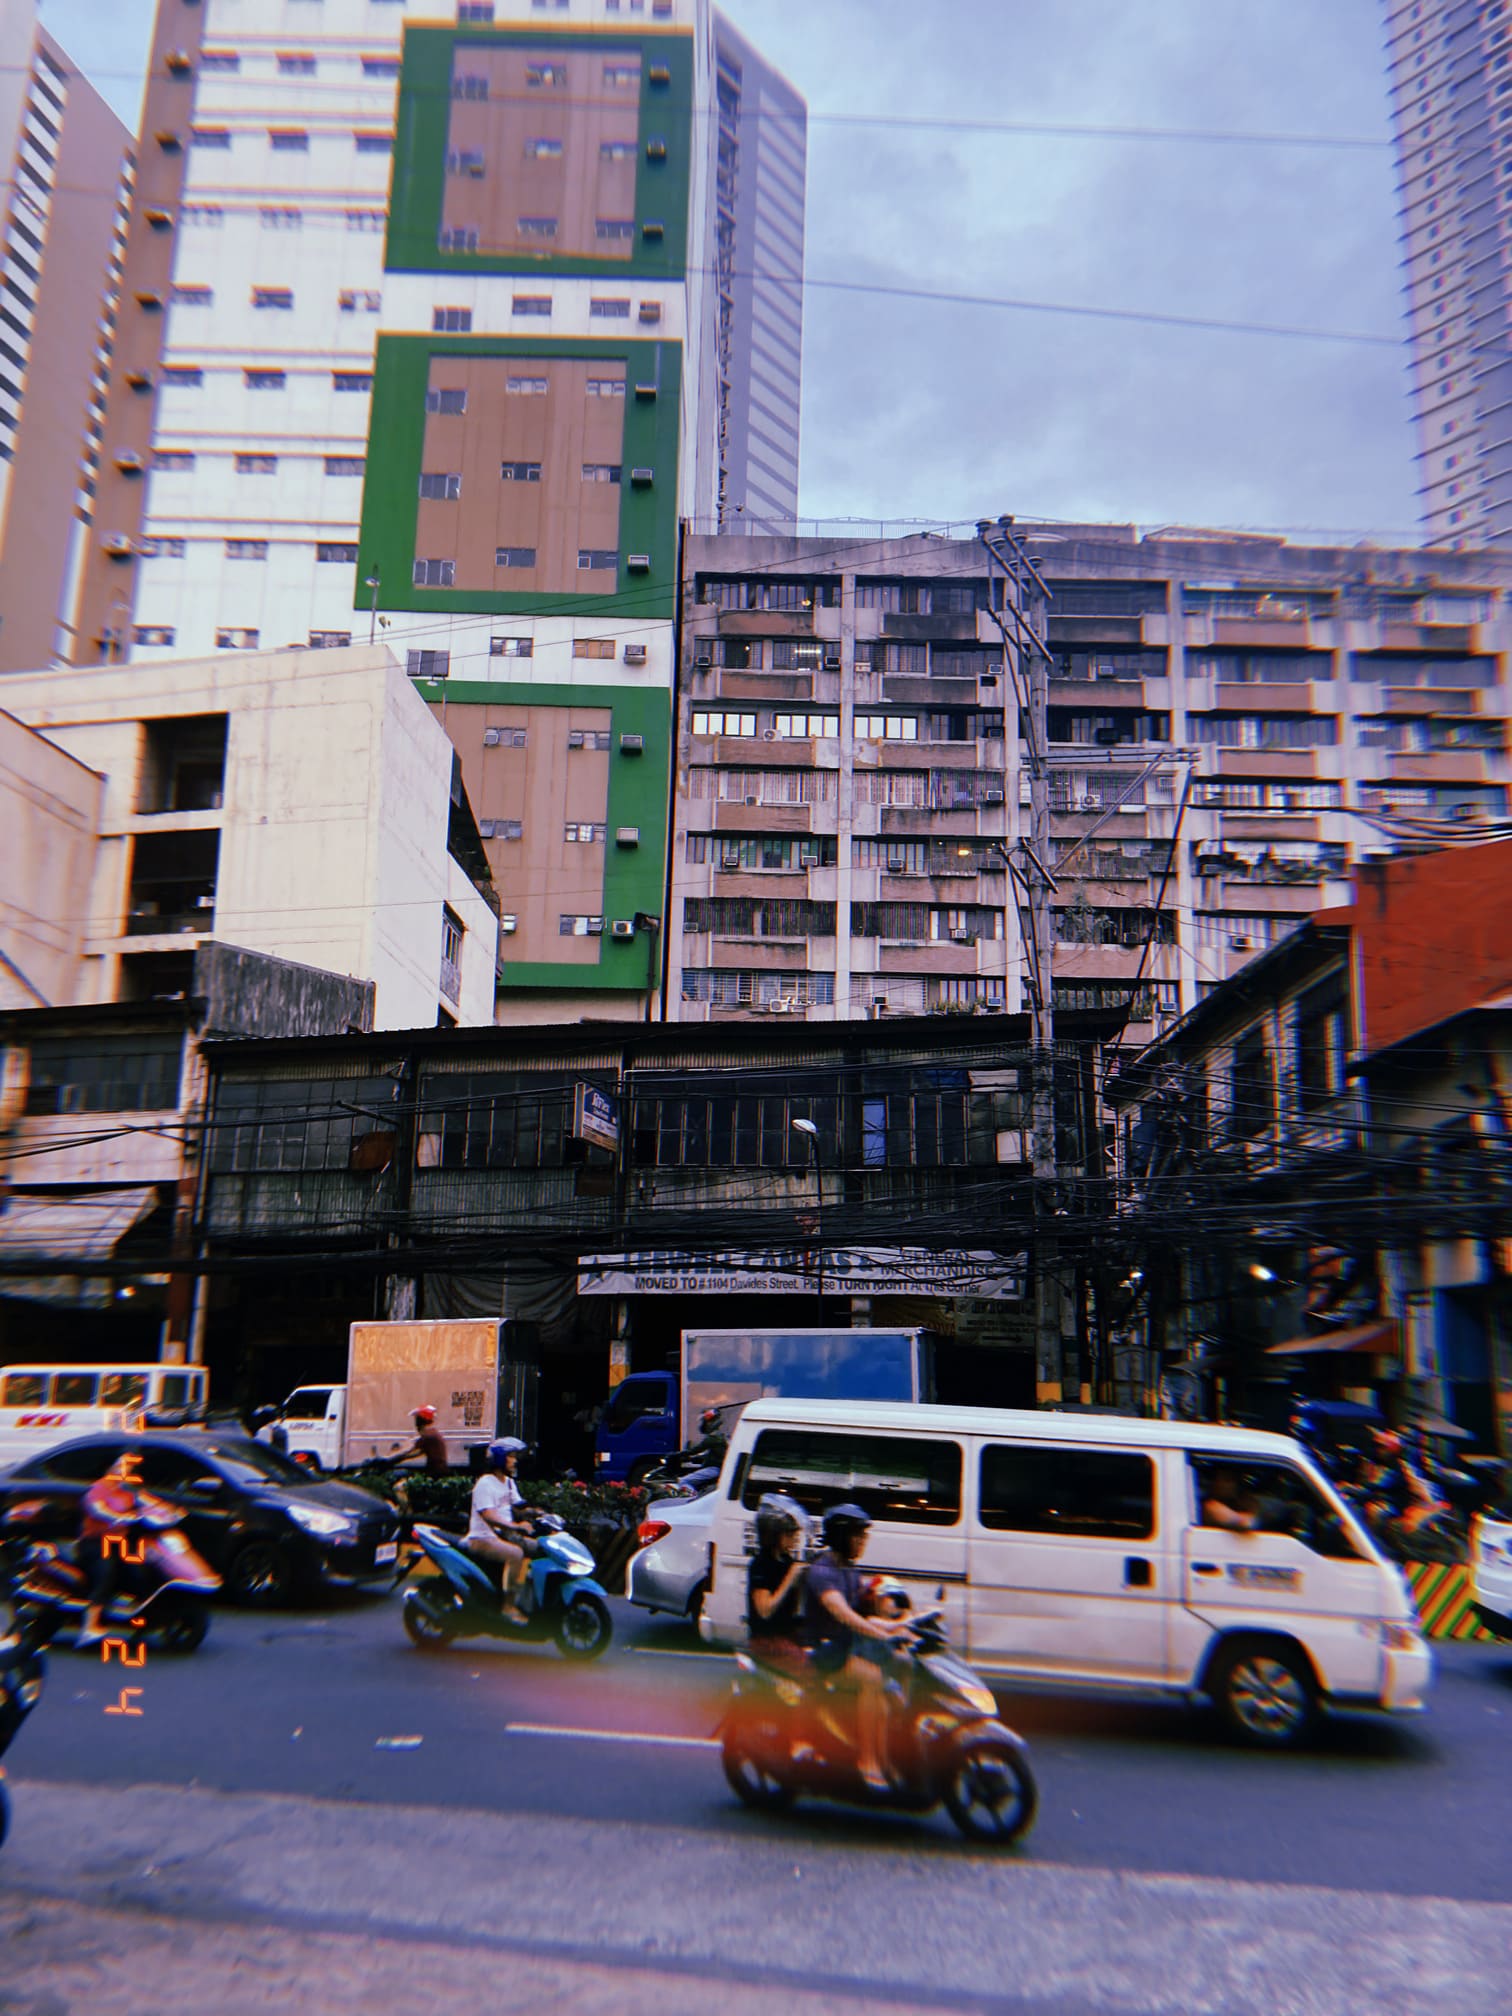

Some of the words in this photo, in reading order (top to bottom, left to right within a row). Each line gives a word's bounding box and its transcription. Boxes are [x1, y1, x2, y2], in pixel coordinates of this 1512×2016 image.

[881, 1263, 995, 1277] MERCHANDISE
[635, 1277, 677, 1289] MOVED
[680, 1277, 697, 1289] TO
[804, 1279, 835, 1290] Plese
[839, 1280, 869, 1290] TURN
